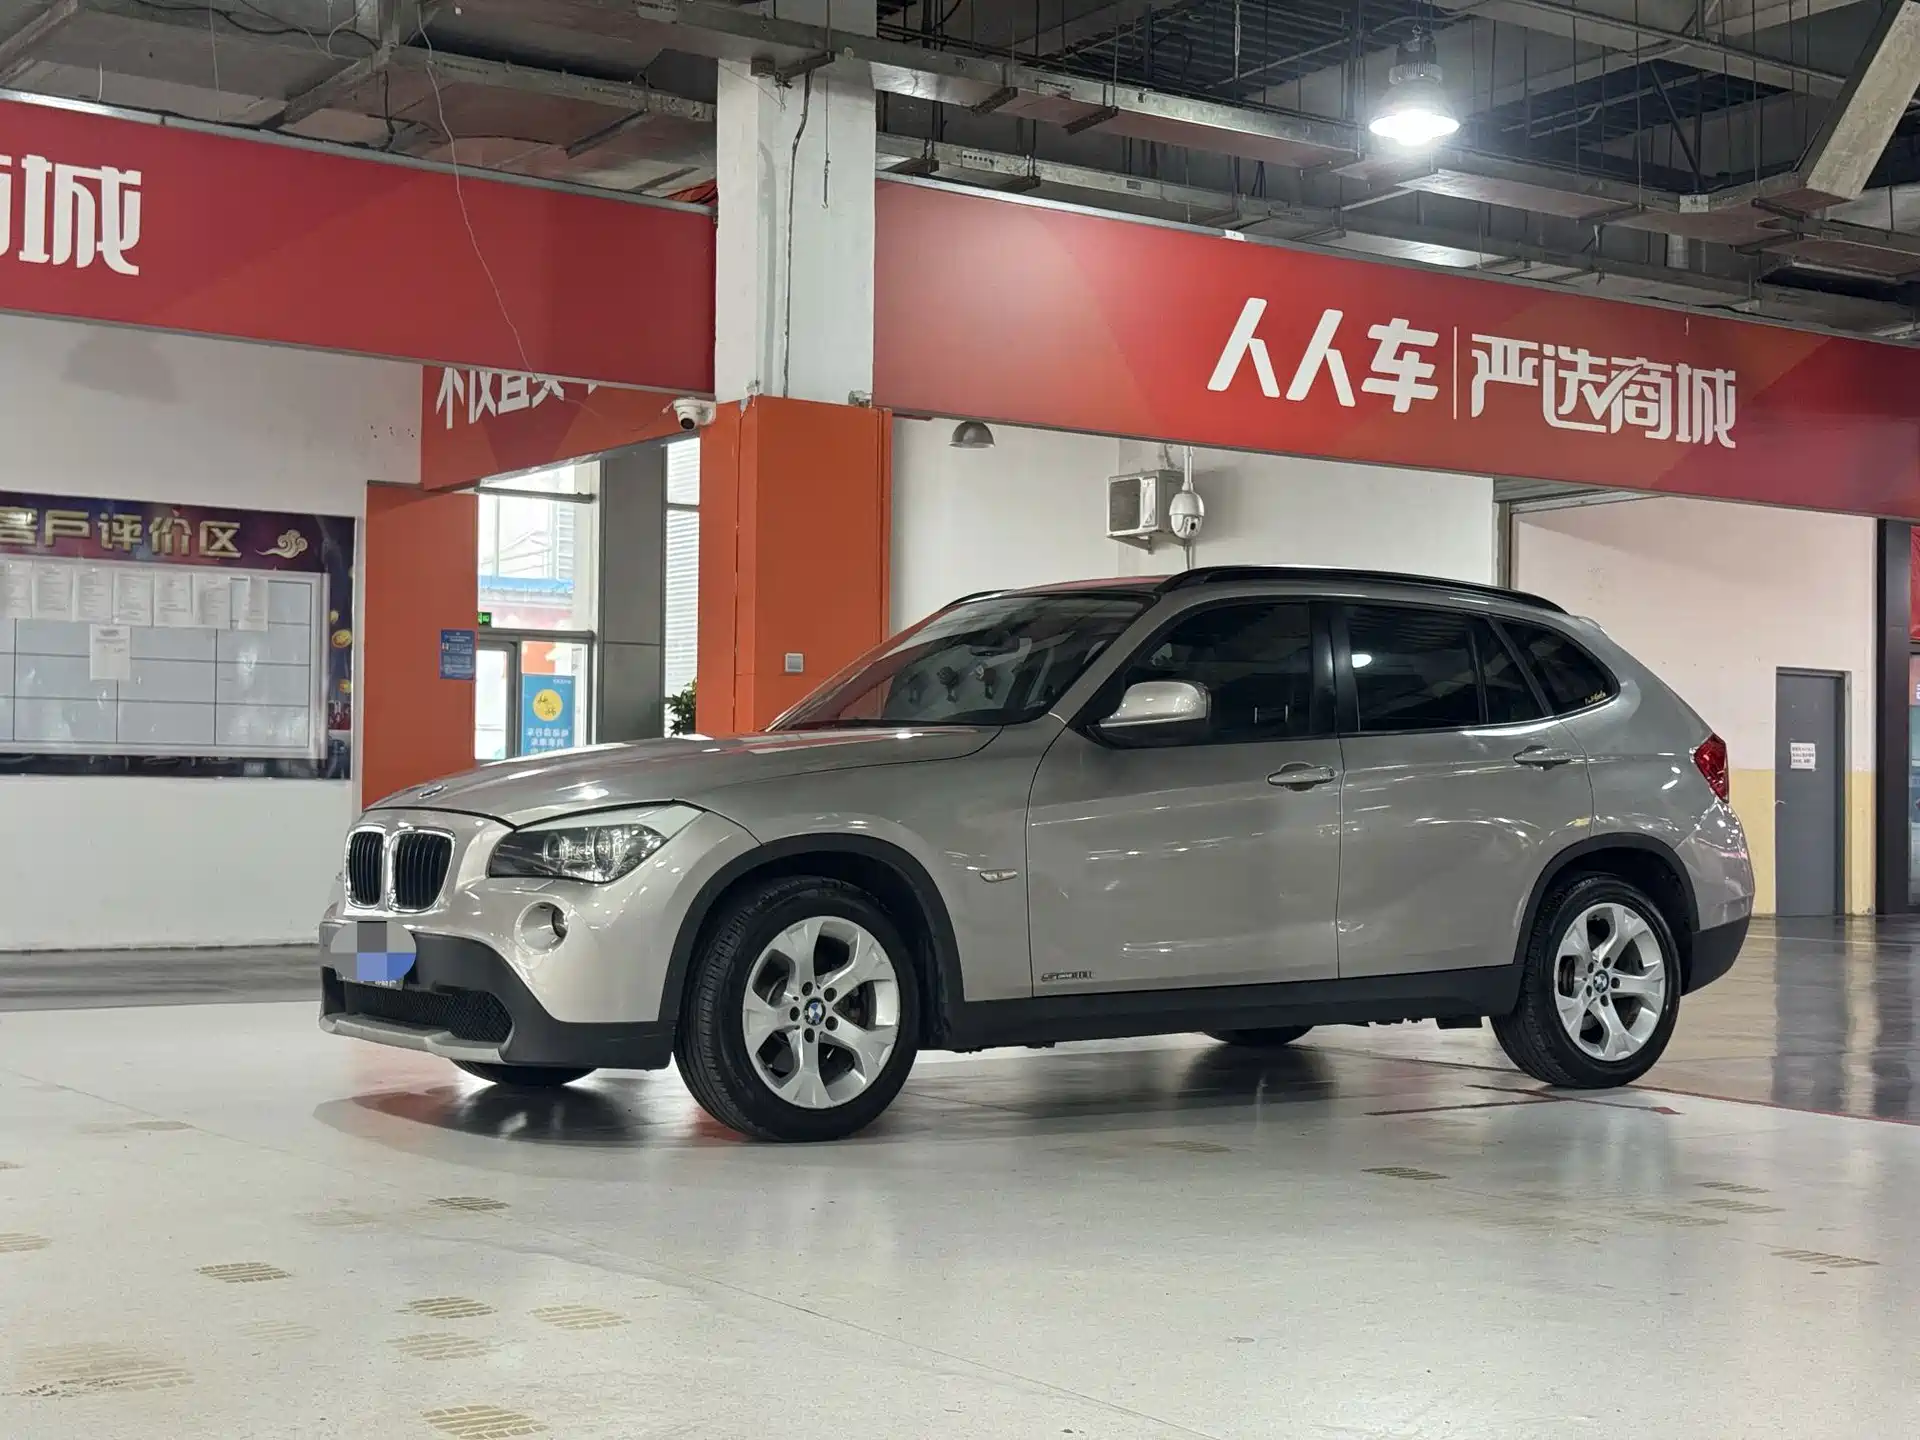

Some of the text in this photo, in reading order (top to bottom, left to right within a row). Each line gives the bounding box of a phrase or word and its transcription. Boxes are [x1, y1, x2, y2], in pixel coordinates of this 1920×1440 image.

[0, 154, 142, 276] 城
[1207, 297, 1736, 449] 人人车 严选商城
[0, 506, 242, 559] 客户评价区
